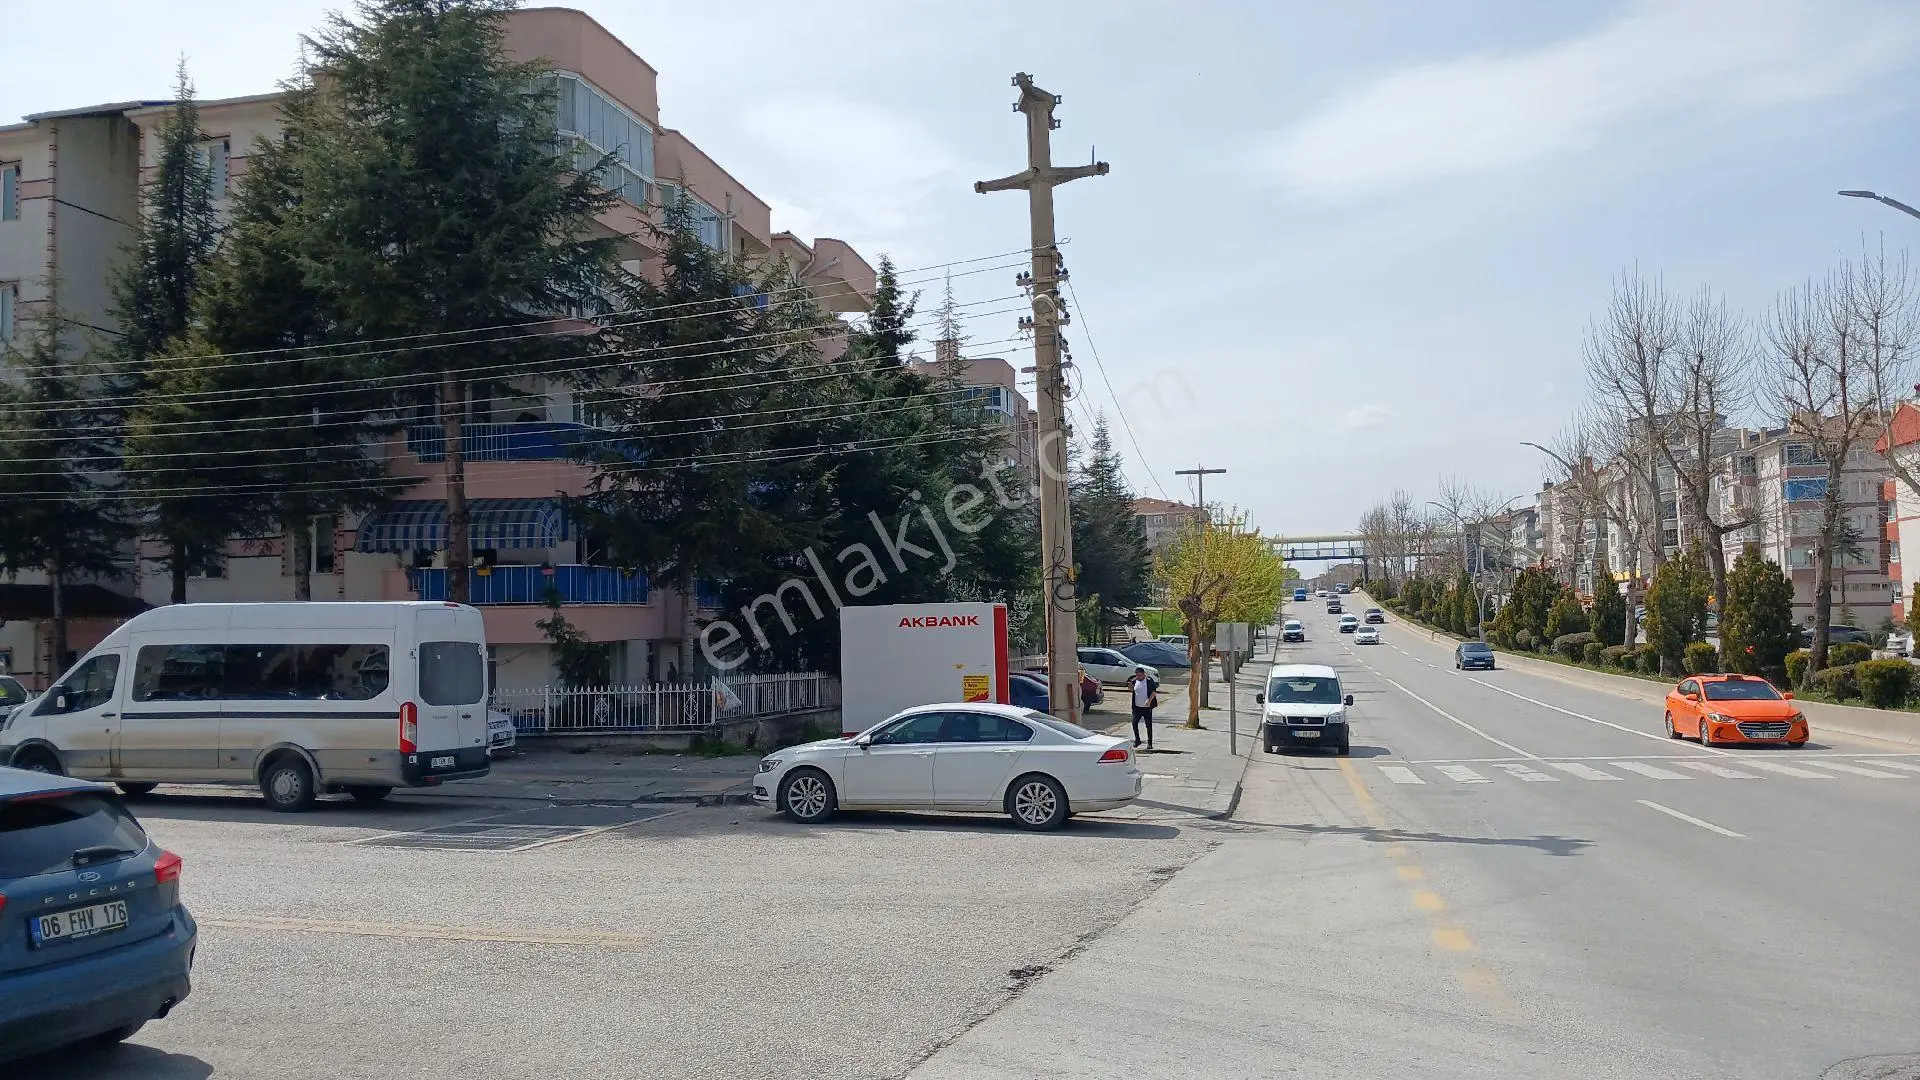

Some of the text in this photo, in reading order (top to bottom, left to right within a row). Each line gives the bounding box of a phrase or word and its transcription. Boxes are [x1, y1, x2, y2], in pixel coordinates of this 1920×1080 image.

[899, 616, 979, 628] AKBANK
[44, 880, 135, 904] FOCUS
[41, 916, 61, 938] 06
[69, 910, 94, 932] FHV
[104, 903, 127, 924] 176
